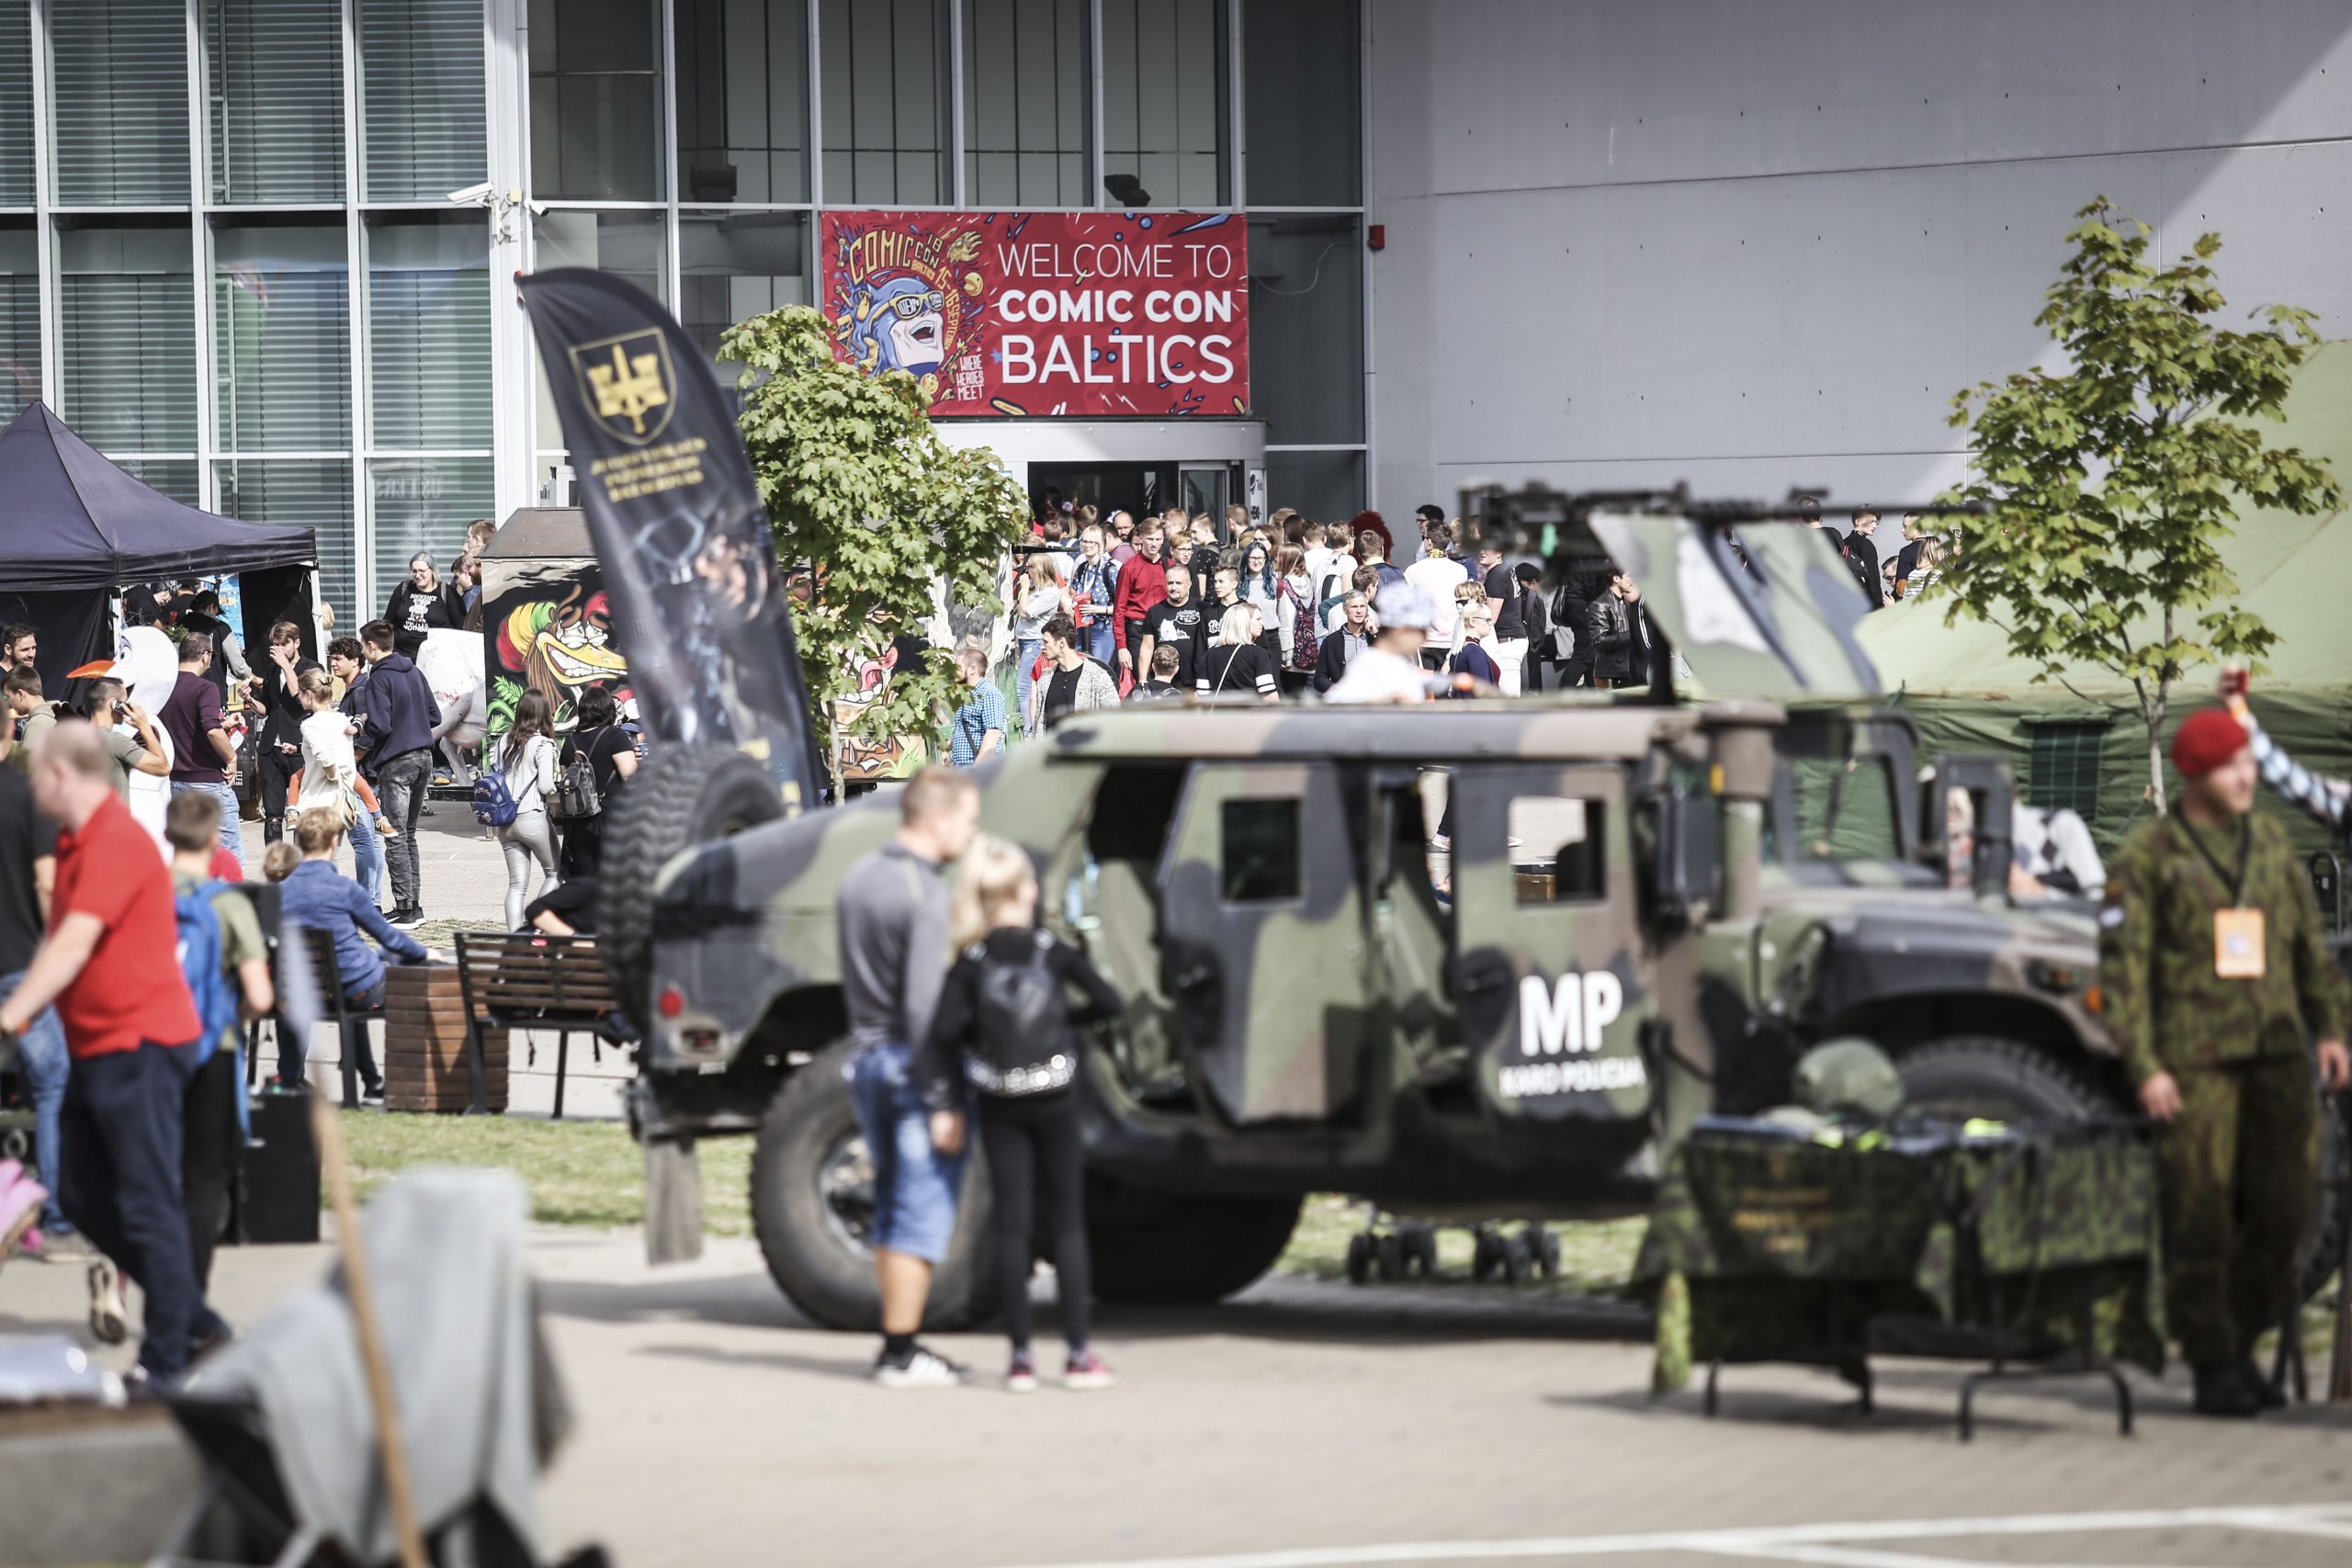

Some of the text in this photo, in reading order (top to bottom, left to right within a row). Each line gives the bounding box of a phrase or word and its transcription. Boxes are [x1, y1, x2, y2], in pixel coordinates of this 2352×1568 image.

[849, 230, 940, 286] COMIC CON
[998, 243, 1231, 278] WELCOME TO
[999, 290, 1231, 322] COMIC CON
[959, 355, 982, 371] WHERE
[1001, 334, 1234, 384] BALTICS
[956, 370, 985, 387] HEROES
[957, 385, 984, 401] MEET
[1519, 970, 1623, 1056] MP
